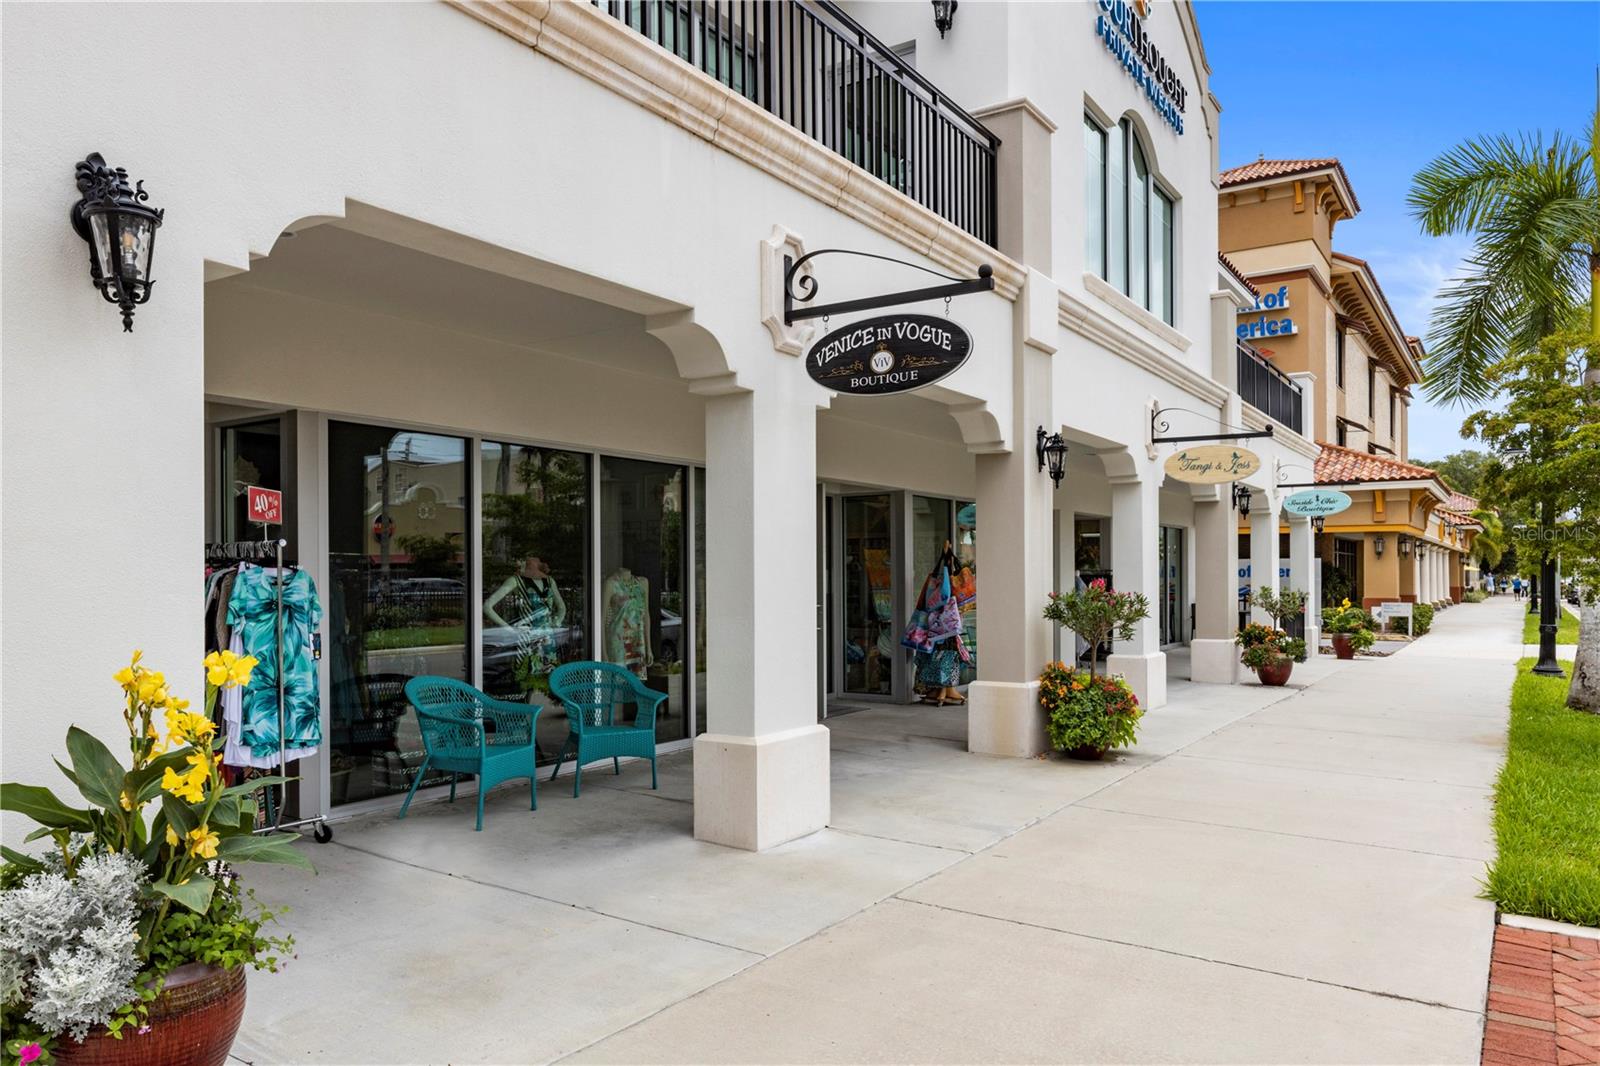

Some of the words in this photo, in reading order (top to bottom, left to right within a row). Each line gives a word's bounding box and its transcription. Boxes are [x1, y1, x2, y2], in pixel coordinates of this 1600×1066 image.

[1096, 15, 1148, 88] PRIVATE
[1145, 76, 1184, 135] WEALTH
[1263, 286, 1288, 309] of
[816, 327, 874, 367] VENICE
[877, 327, 892, 340] IN
[894, 322, 951, 350] VOGUE
[851, 370, 919, 388] BOUTIQUE
[254, 493, 278, 512] 40%
